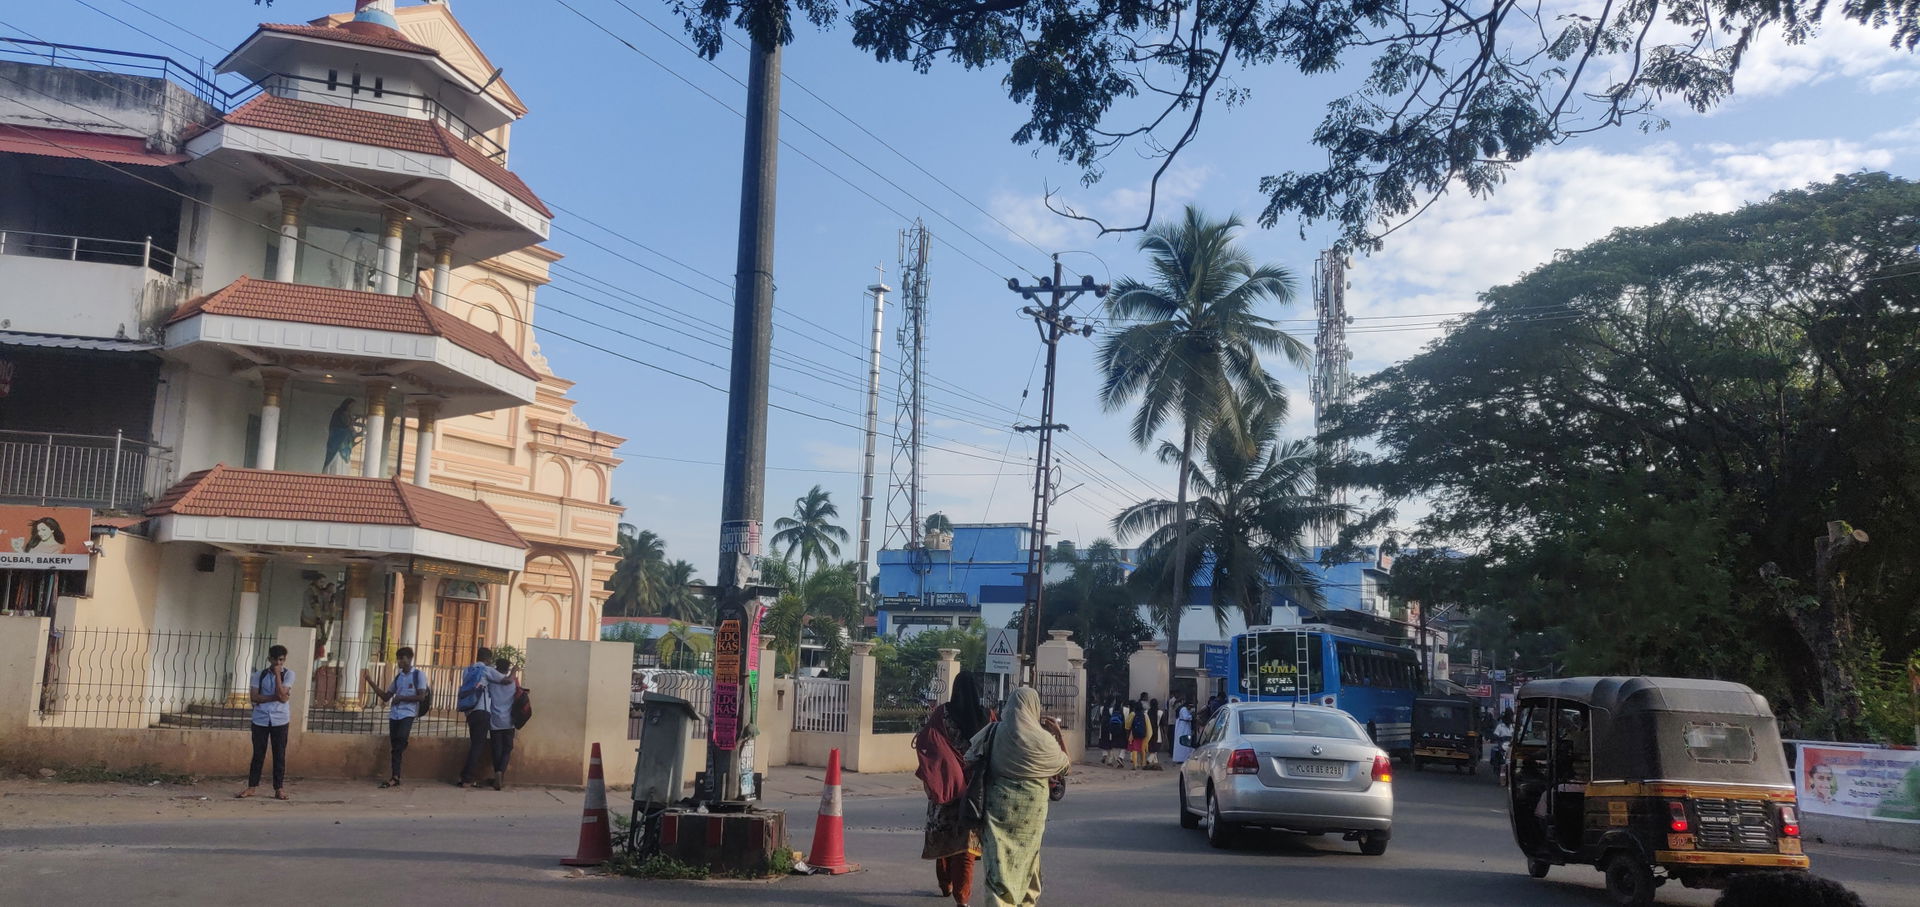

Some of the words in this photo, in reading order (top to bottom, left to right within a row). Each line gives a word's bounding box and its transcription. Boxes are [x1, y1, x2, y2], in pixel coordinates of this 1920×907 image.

[721, 533, 750, 544] MOTOR
[720, 543, 750, 554] SHOW
[36, 557, 73, 565] BAKERY
[718, 632, 739, 642] LDC
[718, 642, 739, 651] KAS
[1260, 666, 1297, 674] SUMA
[717, 695, 736, 704] LDC
[717, 704, 737, 713] KAS
[1423, 732, 1462, 740] ATUL
